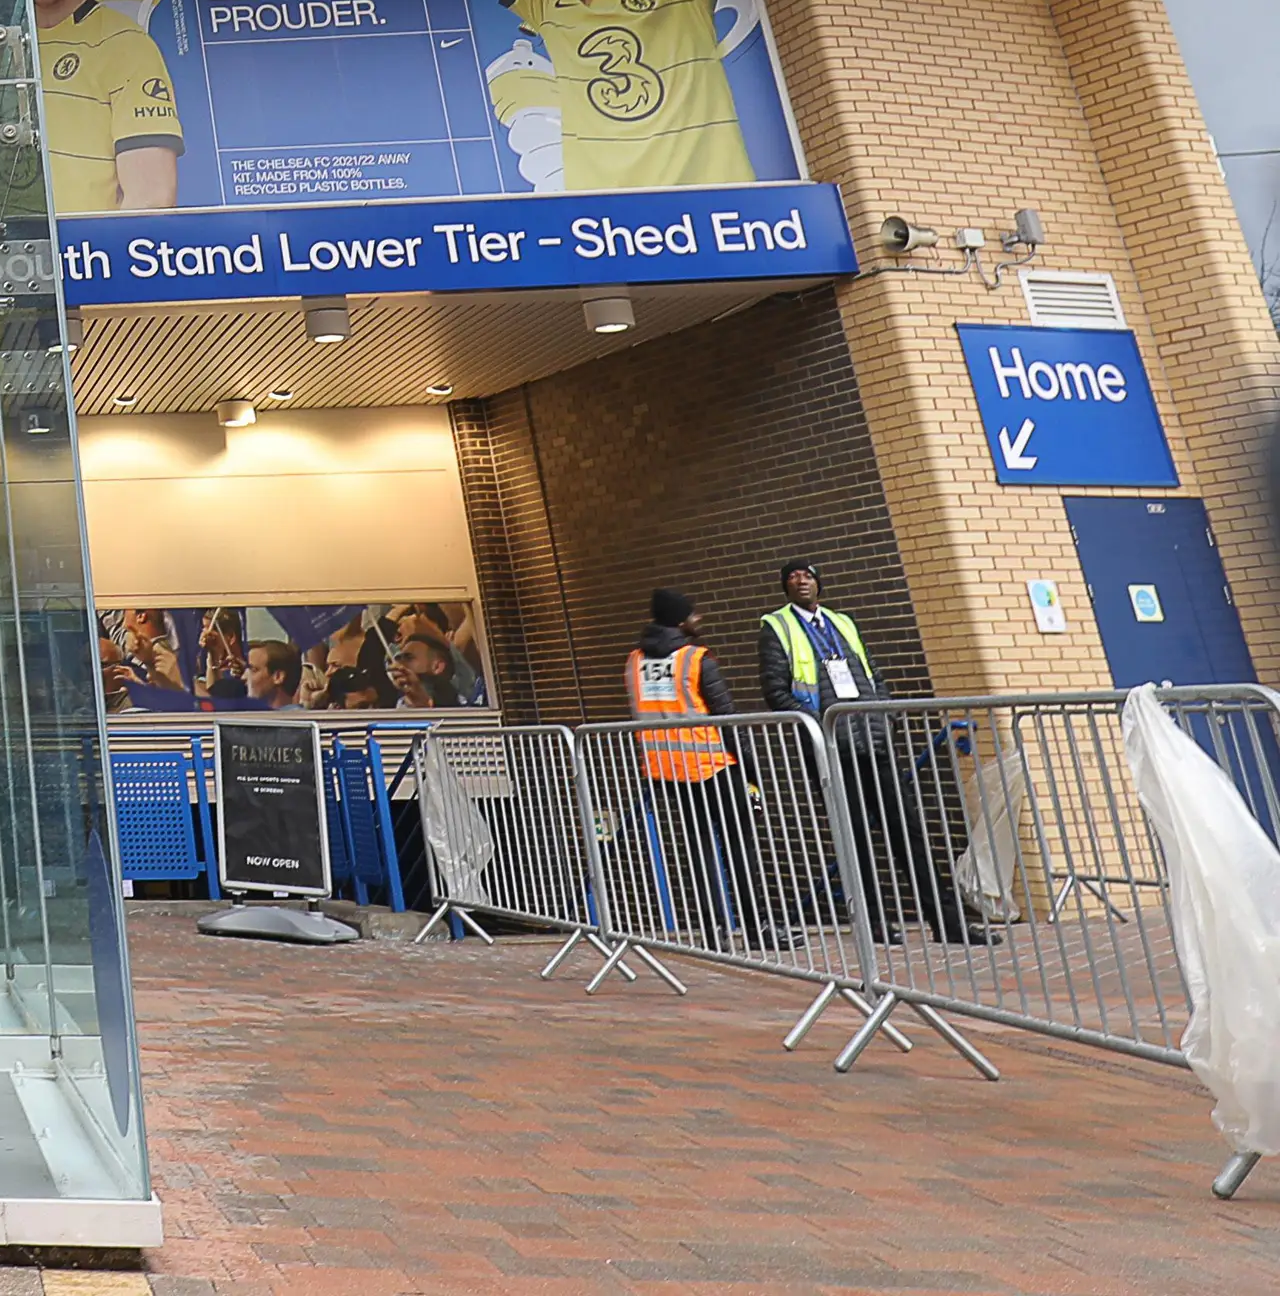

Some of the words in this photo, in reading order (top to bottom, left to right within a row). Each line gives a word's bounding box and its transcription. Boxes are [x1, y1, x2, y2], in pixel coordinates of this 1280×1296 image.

[210, 0, 387, 33] PROUDER.
[231, 159, 255, 171] THE
[257, 157, 312, 170] CHELSEA
[314, 156, 330, 167] FC
[332, 155, 375, 166] 2021/22
[377, 153, 411, 165] AWAY
[256, 170, 291, 182] MADE
[293, 169, 329, 181] FROM
[331, 167, 363, 179] 100%
[235, 182, 297, 196] RECYCLED
[299, 180, 349, 193] PLASTIC
[351, 178, 408, 192] BOTTLES.
[127, 233, 264, 279] Stand
[279, 231, 422, 273] Lower
[433, 223, 525, 263] Tier
[571, 213, 698, 258] Shed
[711, 209, 807, 253] End
[988, 346, 1128, 402] Home
[640, 663, 674, 682] 154
[231, 745, 302, 763] FRANKIE'S
[246, 856, 271, 866] NOW
[272, 858, 300, 869] OPEN
